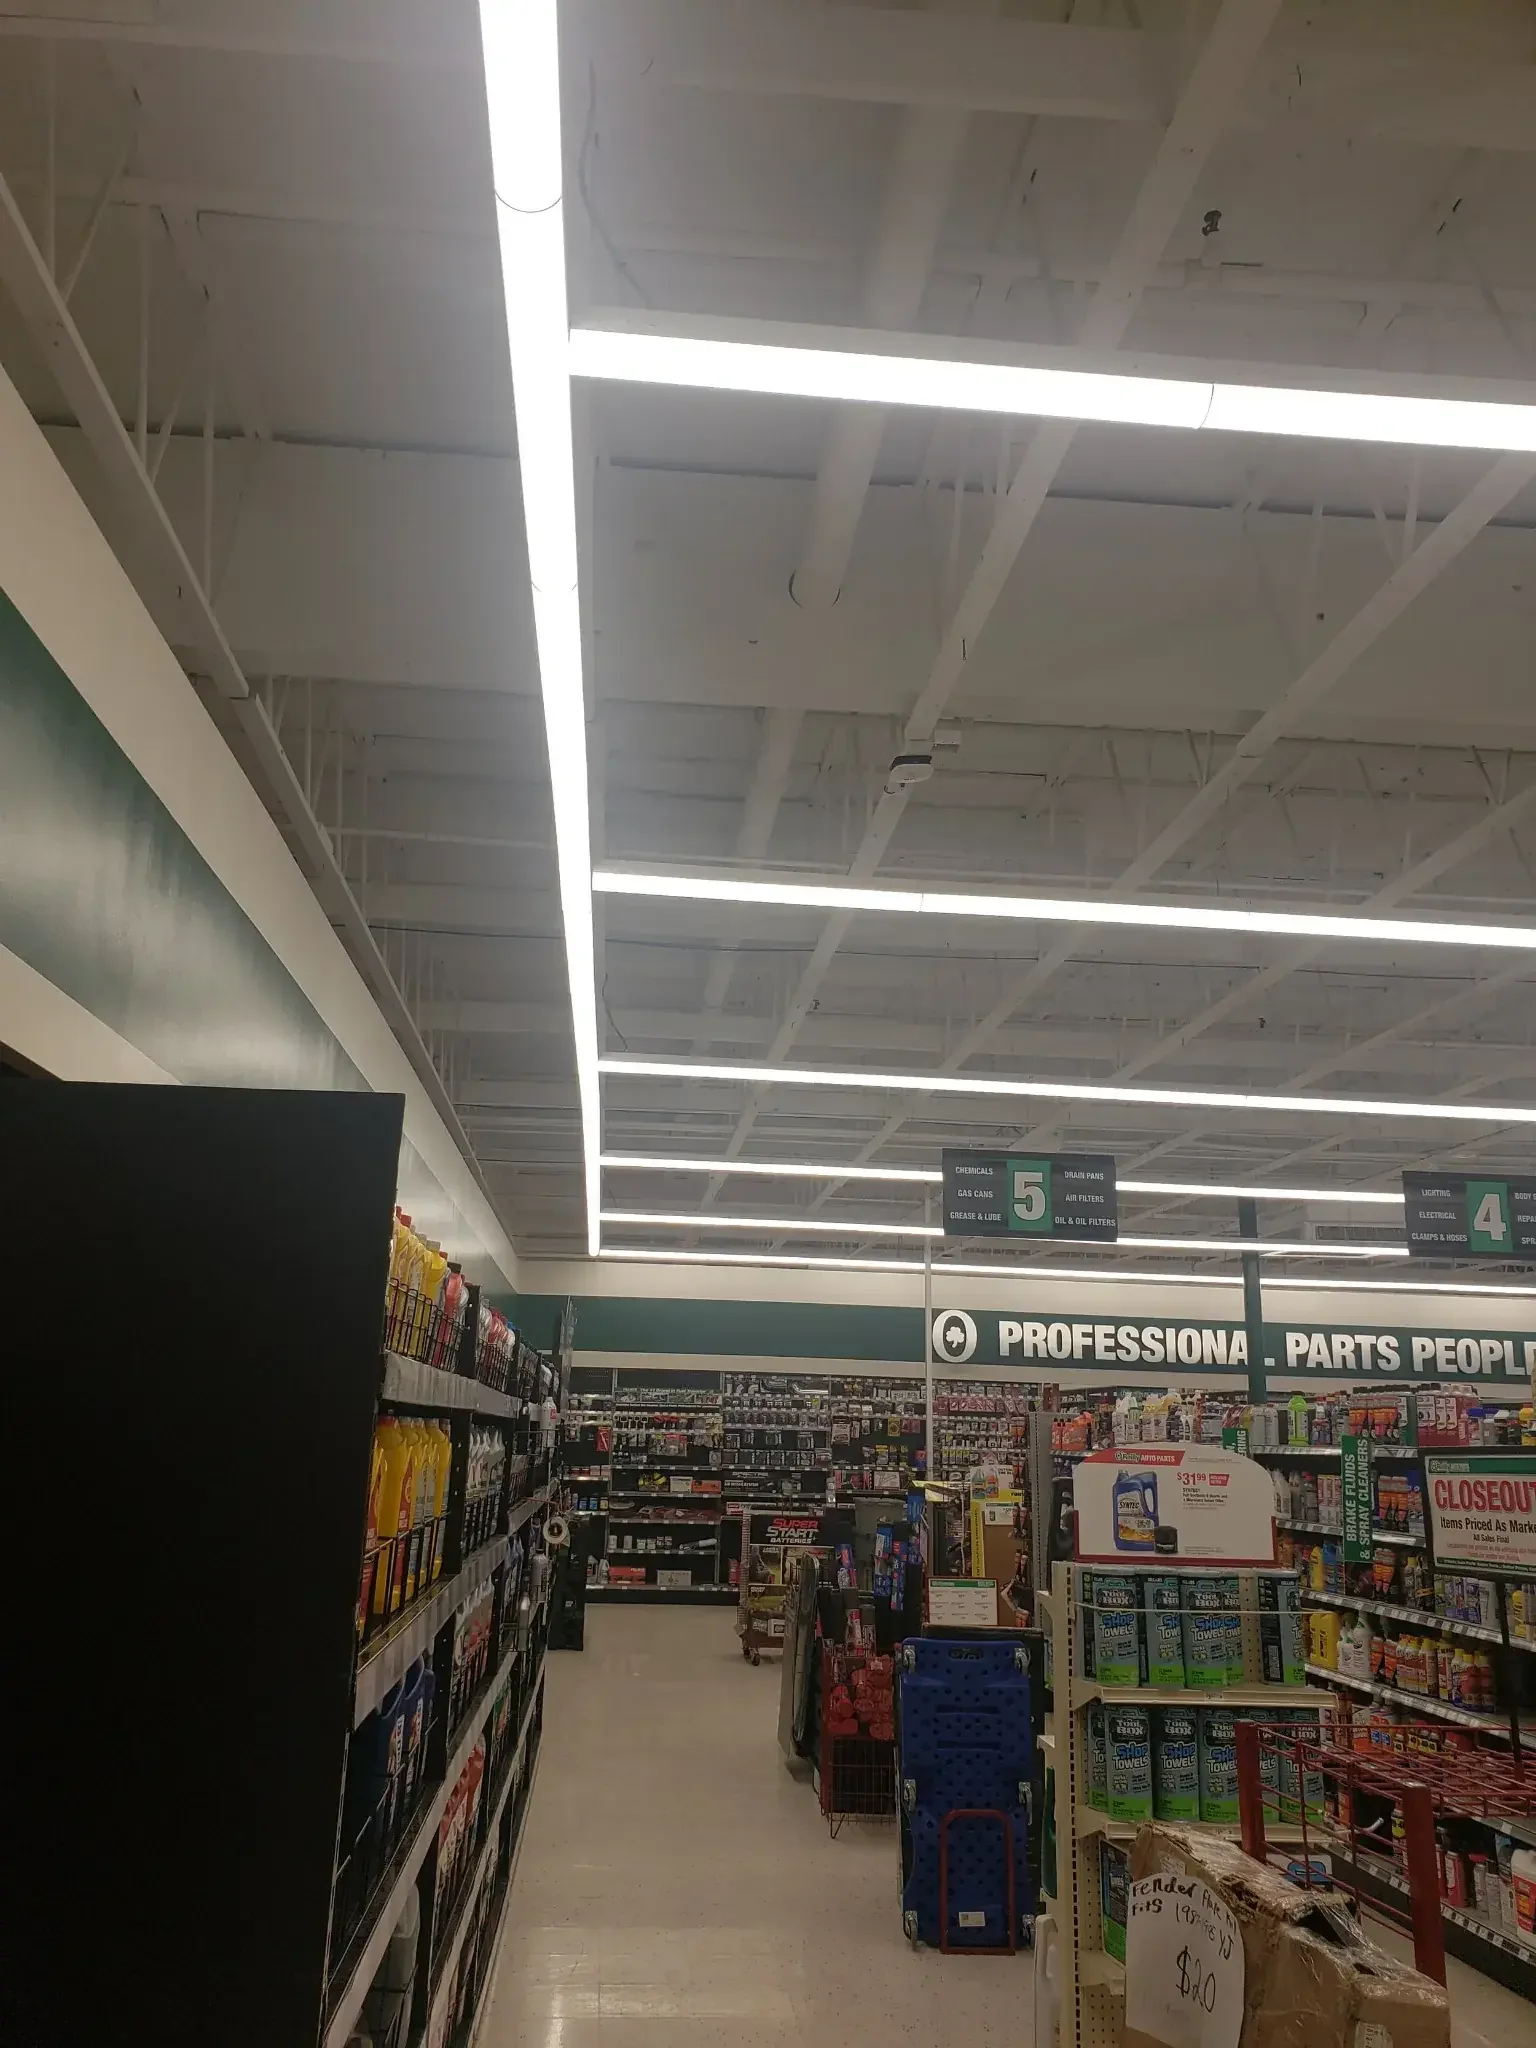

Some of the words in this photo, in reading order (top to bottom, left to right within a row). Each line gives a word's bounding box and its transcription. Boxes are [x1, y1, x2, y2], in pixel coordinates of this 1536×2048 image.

[956, 1166, 994, 1176] CHEMICALS
[1064, 1171, 1085, 1180] DRAIN
[1086, 1172, 1104, 1180] PANS
[957, 1190, 972, 1198] GAS
[974, 1190, 994, 1198] CANS
[1013, 1171, 1046, 1221] 5
[1065, 1194, 1077, 1202] AIR
[1078, 1194, 1104, 1203] FILTERS
[1421, 1189, 1450, 1197] LIGHTING
[950, 1212, 976, 1220] GREASE
[984, 1213, 1002, 1221] LUBE
[1055, 1216, 1066, 1224] OIL
[1075, 1217, 1087, 1225] OIL
[1088, 1218, 1116, 1227] FILTERS
[1419, 1211, 1456, 1220] ELECTRICAL
[1474, 1193, 1506, 1240] 4
[1412, 1233, 1438, 1241] CLAMPS
[1286, 1332, 1400, 1371] PARTS
[1141, 1453, 1155, 1462] AUTO
[1156, 1454, 1175, 1463] PARTS
[1345, 1454, 1356, 1497] FLUIDS
[1357, 1439, 1369, 1501] CLEANERS
[772, 1519, 818, 1528] SUPER
[1346, 1500, 1357, 1542] BRAKE
[1359, 1504, 1370, 1546] SPRAY
[1440, 1516, 1463, 1529] Items
[1465, 1517, 1493, 1531] Priced
[1495, 1521, 1507, 1532] As
[766, 1526, 819, 1538] START
[1481, 1534, 1495, 1543] Sales
[1360, 1551, 1370, 1559] &
[1102, 1612, 1134, 1626] SHOP
[1100, 1624, 1135, 1638] TOWELS
[1116, 1726, 1144, 1735] BOX
[1164, 1726, 1192, 1735] BOX
[1116, 1744, 1148, 1758] SHOP
[1165, 1743, 1195, 1758] SHOP
[1113, 1757, 1150, 1770] TOWELS
[1161, 1756, 1196, 1769] TOWELS
[1132, 1877, 1199, 1898] Fender
[1219, 1930, 1234, 1960] YJ
[1176, 1945, 1216, 2013] $20
